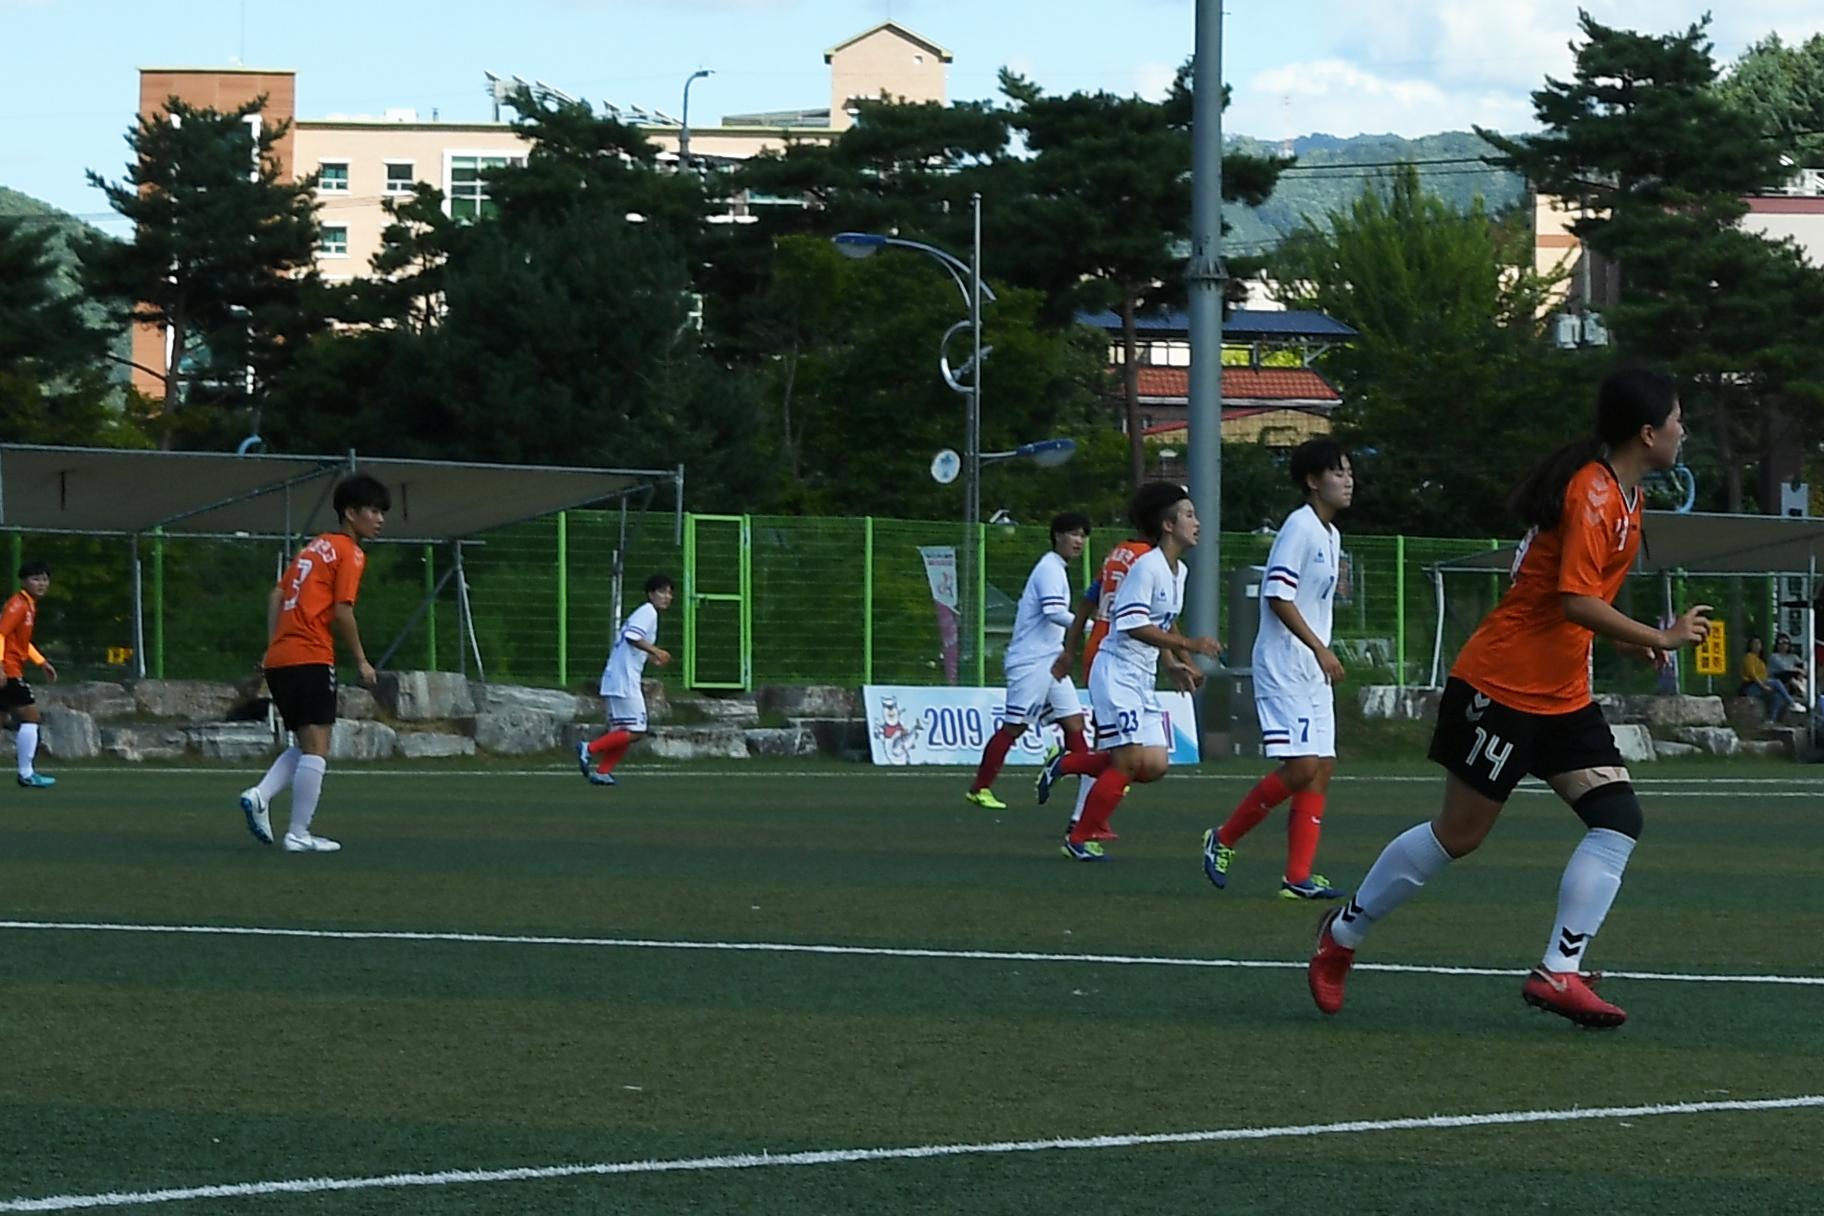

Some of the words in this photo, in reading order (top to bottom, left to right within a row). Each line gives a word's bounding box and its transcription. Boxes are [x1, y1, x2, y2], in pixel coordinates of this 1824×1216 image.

[924, 707, 982, 747] 2019
[1117, 710, 1139, 733] 23
[1298, 718, 1310, 742] 7
[1465, 726, 1514, 782] 14
